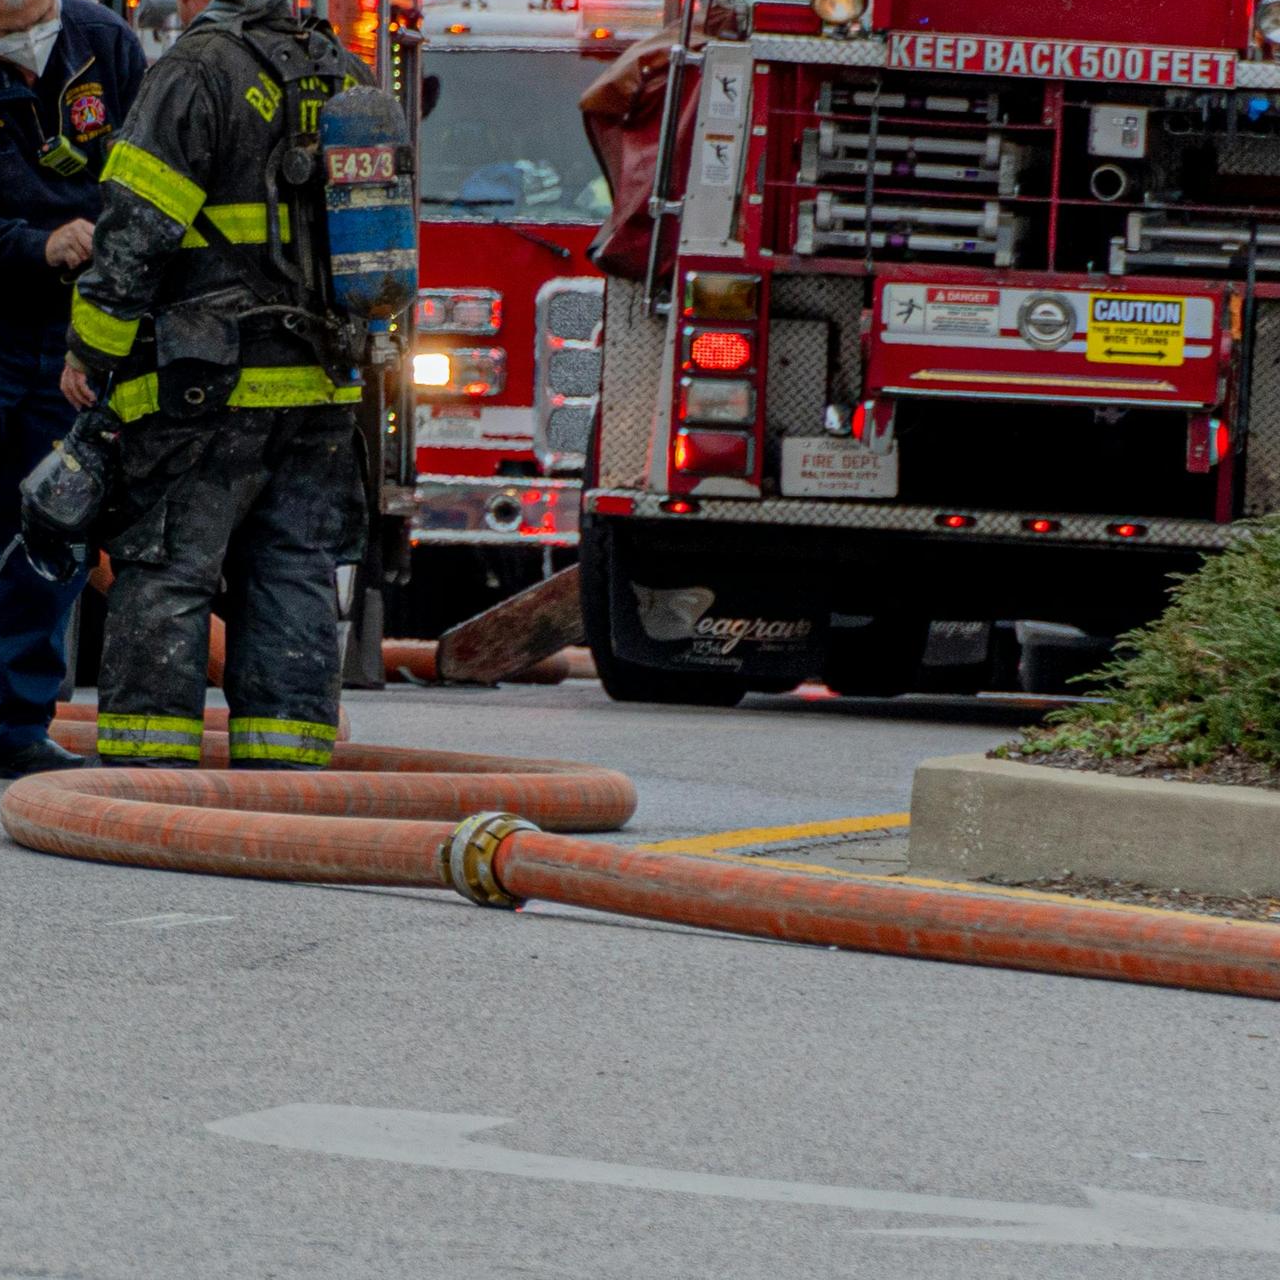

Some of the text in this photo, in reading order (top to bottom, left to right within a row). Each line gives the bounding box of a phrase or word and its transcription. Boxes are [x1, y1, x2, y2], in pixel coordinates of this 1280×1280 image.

[891, 33, 1233, 87] KEEP BACK 500 FEET
[330, 151, 393, 179] E43/3
[1095, 300, 1181, 324] CAUTION
[1104, 335, 1169, 346] WIDE TURNS
[802, 454, 834, 468] FIRE
